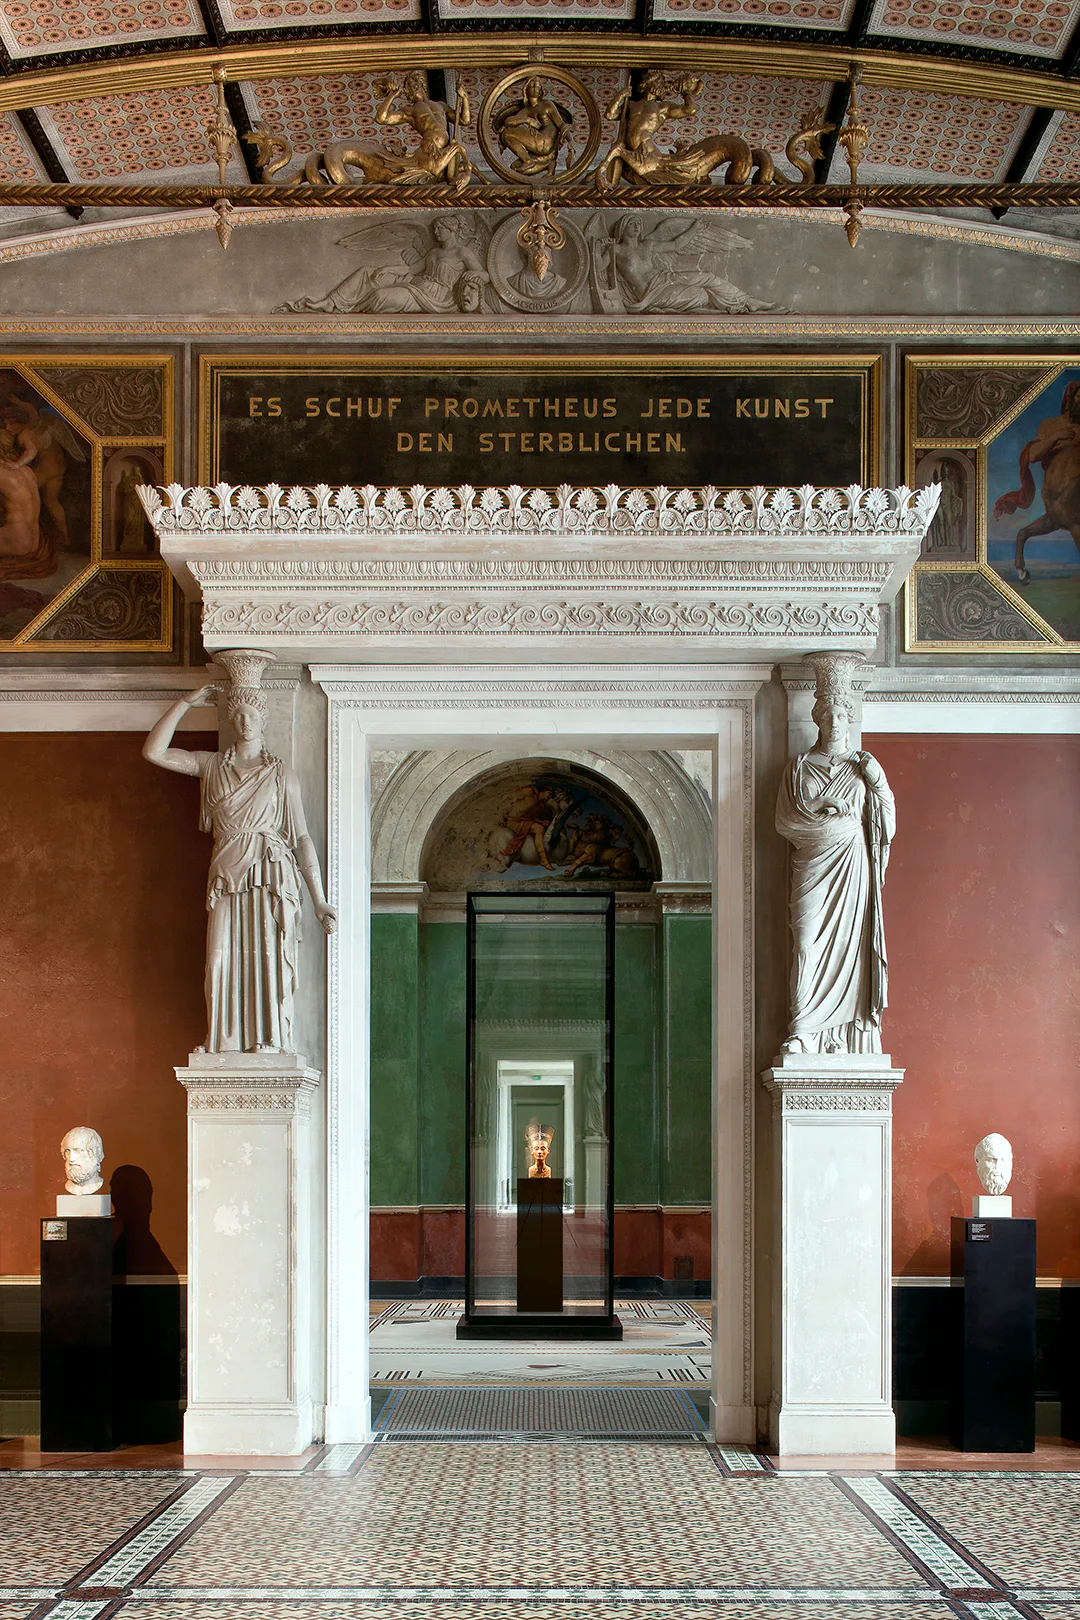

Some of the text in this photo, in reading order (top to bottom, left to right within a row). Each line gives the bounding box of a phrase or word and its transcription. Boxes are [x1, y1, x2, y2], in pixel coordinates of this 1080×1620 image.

[516, 299, 558, 310] AESCHYLUS
[249, 397, 835, 418] ES SCHUF PROMETHEUS JEDE KUNST
[397, 432, 686, 452] DEN STERBLICHEN.
